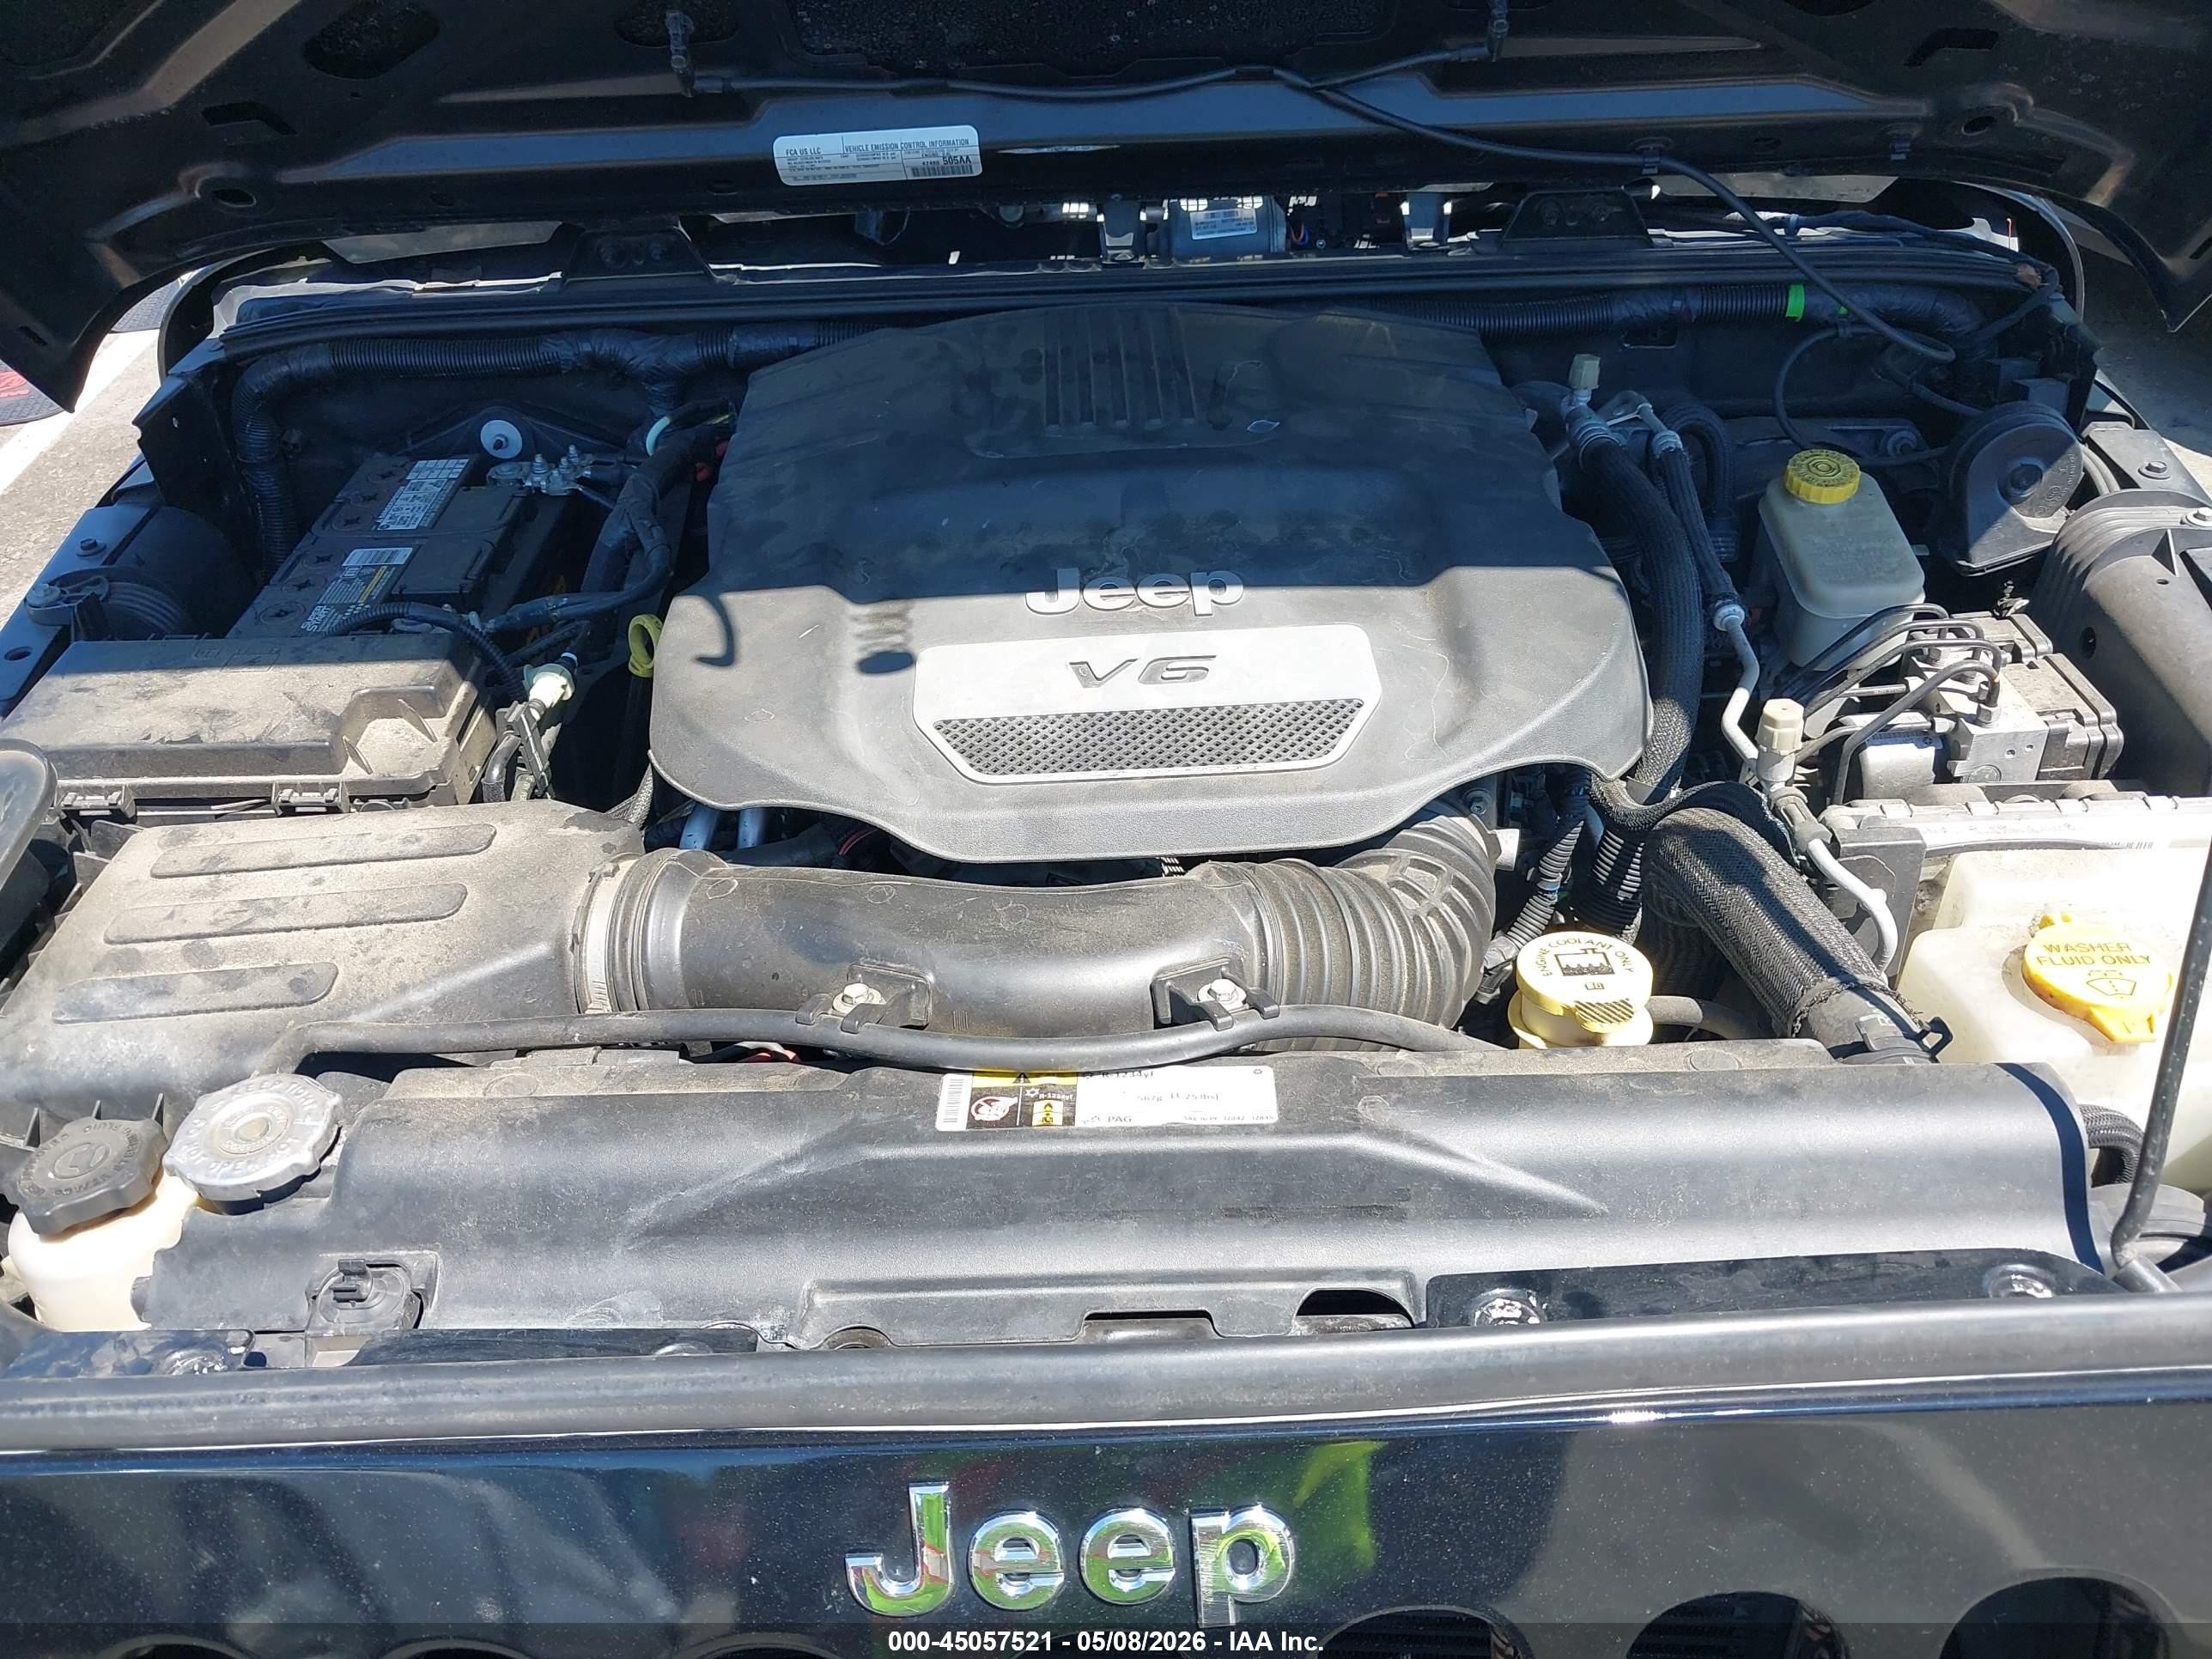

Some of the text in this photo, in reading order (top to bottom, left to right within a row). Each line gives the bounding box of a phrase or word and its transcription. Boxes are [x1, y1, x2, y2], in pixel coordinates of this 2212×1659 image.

[844, 143, 870, 153] VEHICLE
[871, 141, 899, 152] EMISSION
[900, 140, 927, 149] CONTROL
[928, 137, 969, 147] INFORMATION
[942, 155, 972, 165] 505AA
[1024, 567, 1244, 617] Jeep
[301, 605, 324, 629] SUPER
[307, 605, 331, 633] START
[1068, 654, 1217, 689] V6
[1534, 938, 1636, 977] ENGINE COOLANT ONLY
[2043, 941, 2132, 953] WASHER
[2036, 954, 2151, 967] FLUID ONLY
[230, 1079, 283, 1097] KEEP
[82, 1121, 124, 1133] FLUID
[187, 1118, 207, 1137] DO
[179, 1143, 209, 1167] NOT
[54, 1173, 112, 1197] POWER
[844, 1480, 1296, 1629] Jeep
